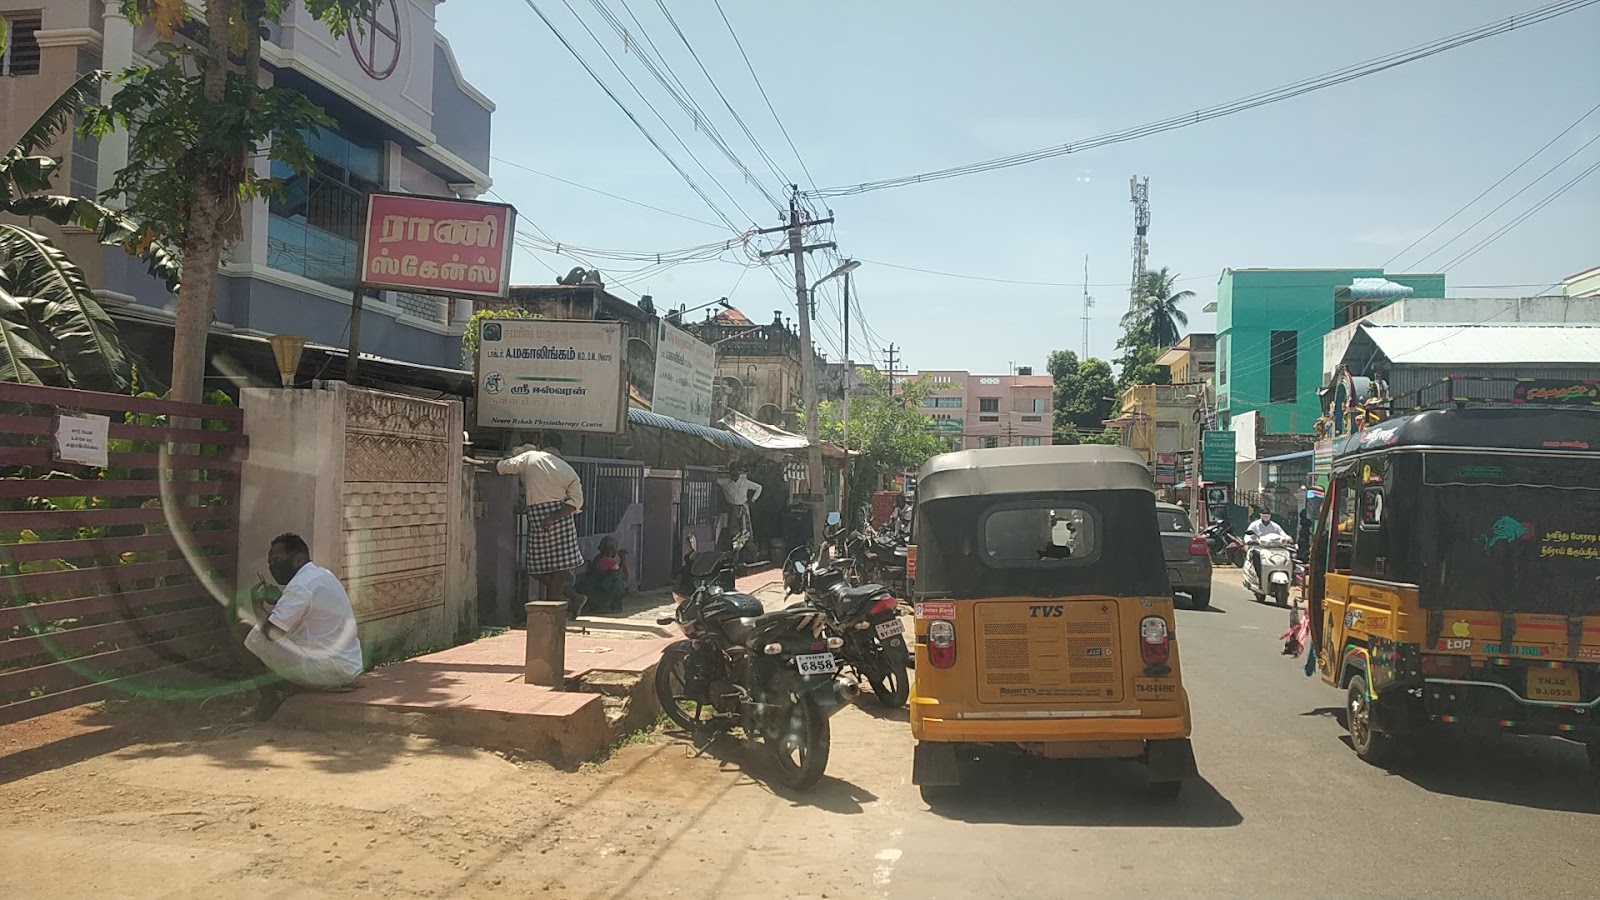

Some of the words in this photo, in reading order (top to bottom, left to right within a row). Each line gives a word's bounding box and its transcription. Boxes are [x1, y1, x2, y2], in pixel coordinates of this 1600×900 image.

[379, 214, 498, 248] ராணி
[371, 248, 497, 284] ஸ்கேன்ஸ்
[534, 419, 580, 428] Physiotherapy
[1029, 605, 1063, 617] TVS
[801, 660, 833, 671] 6858
